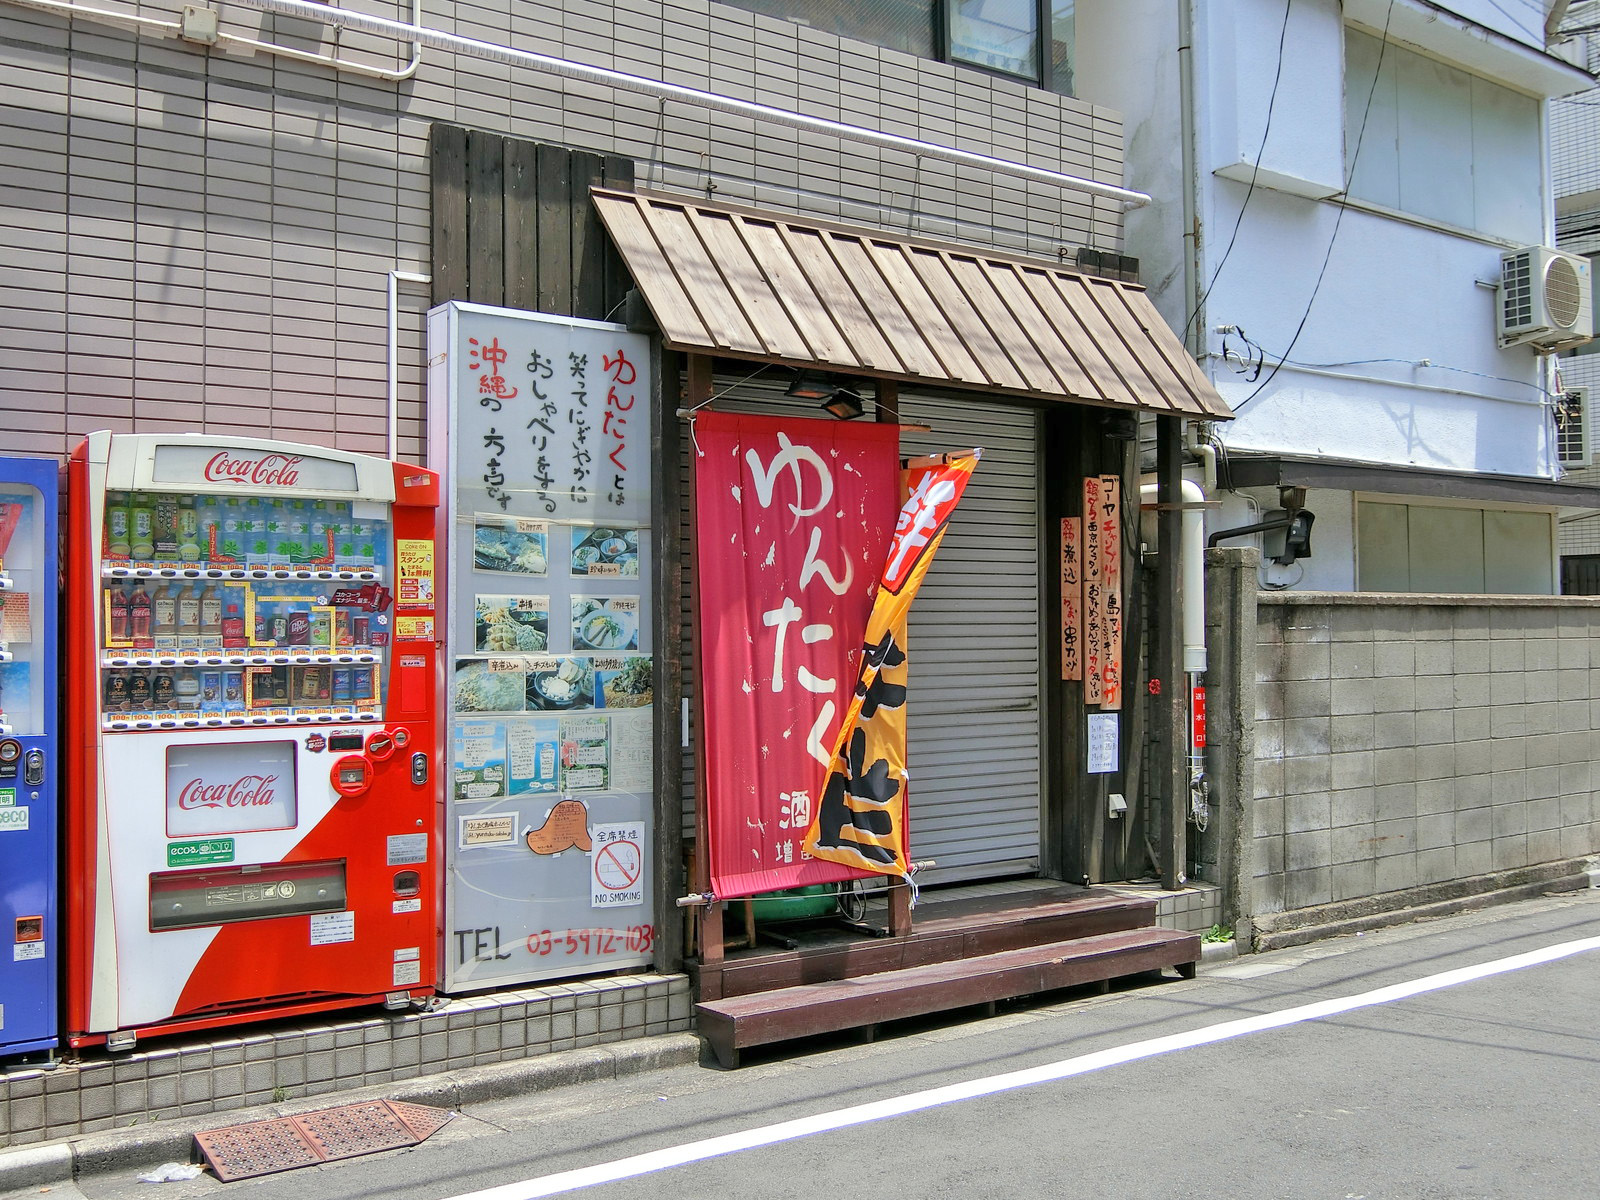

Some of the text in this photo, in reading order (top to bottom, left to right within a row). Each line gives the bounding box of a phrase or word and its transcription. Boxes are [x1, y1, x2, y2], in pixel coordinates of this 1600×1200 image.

[526, 349, 558, 513] おしゃべりをする
[204, 451, 304, 486] Coca-Cola
[178, 774, 280, 811] Coca-Cola
[596, 831, 639, 843] 全席禁煙
[595, 891, 641, 904] NO SMOKING
[454, 926, 512, 965] TEL
